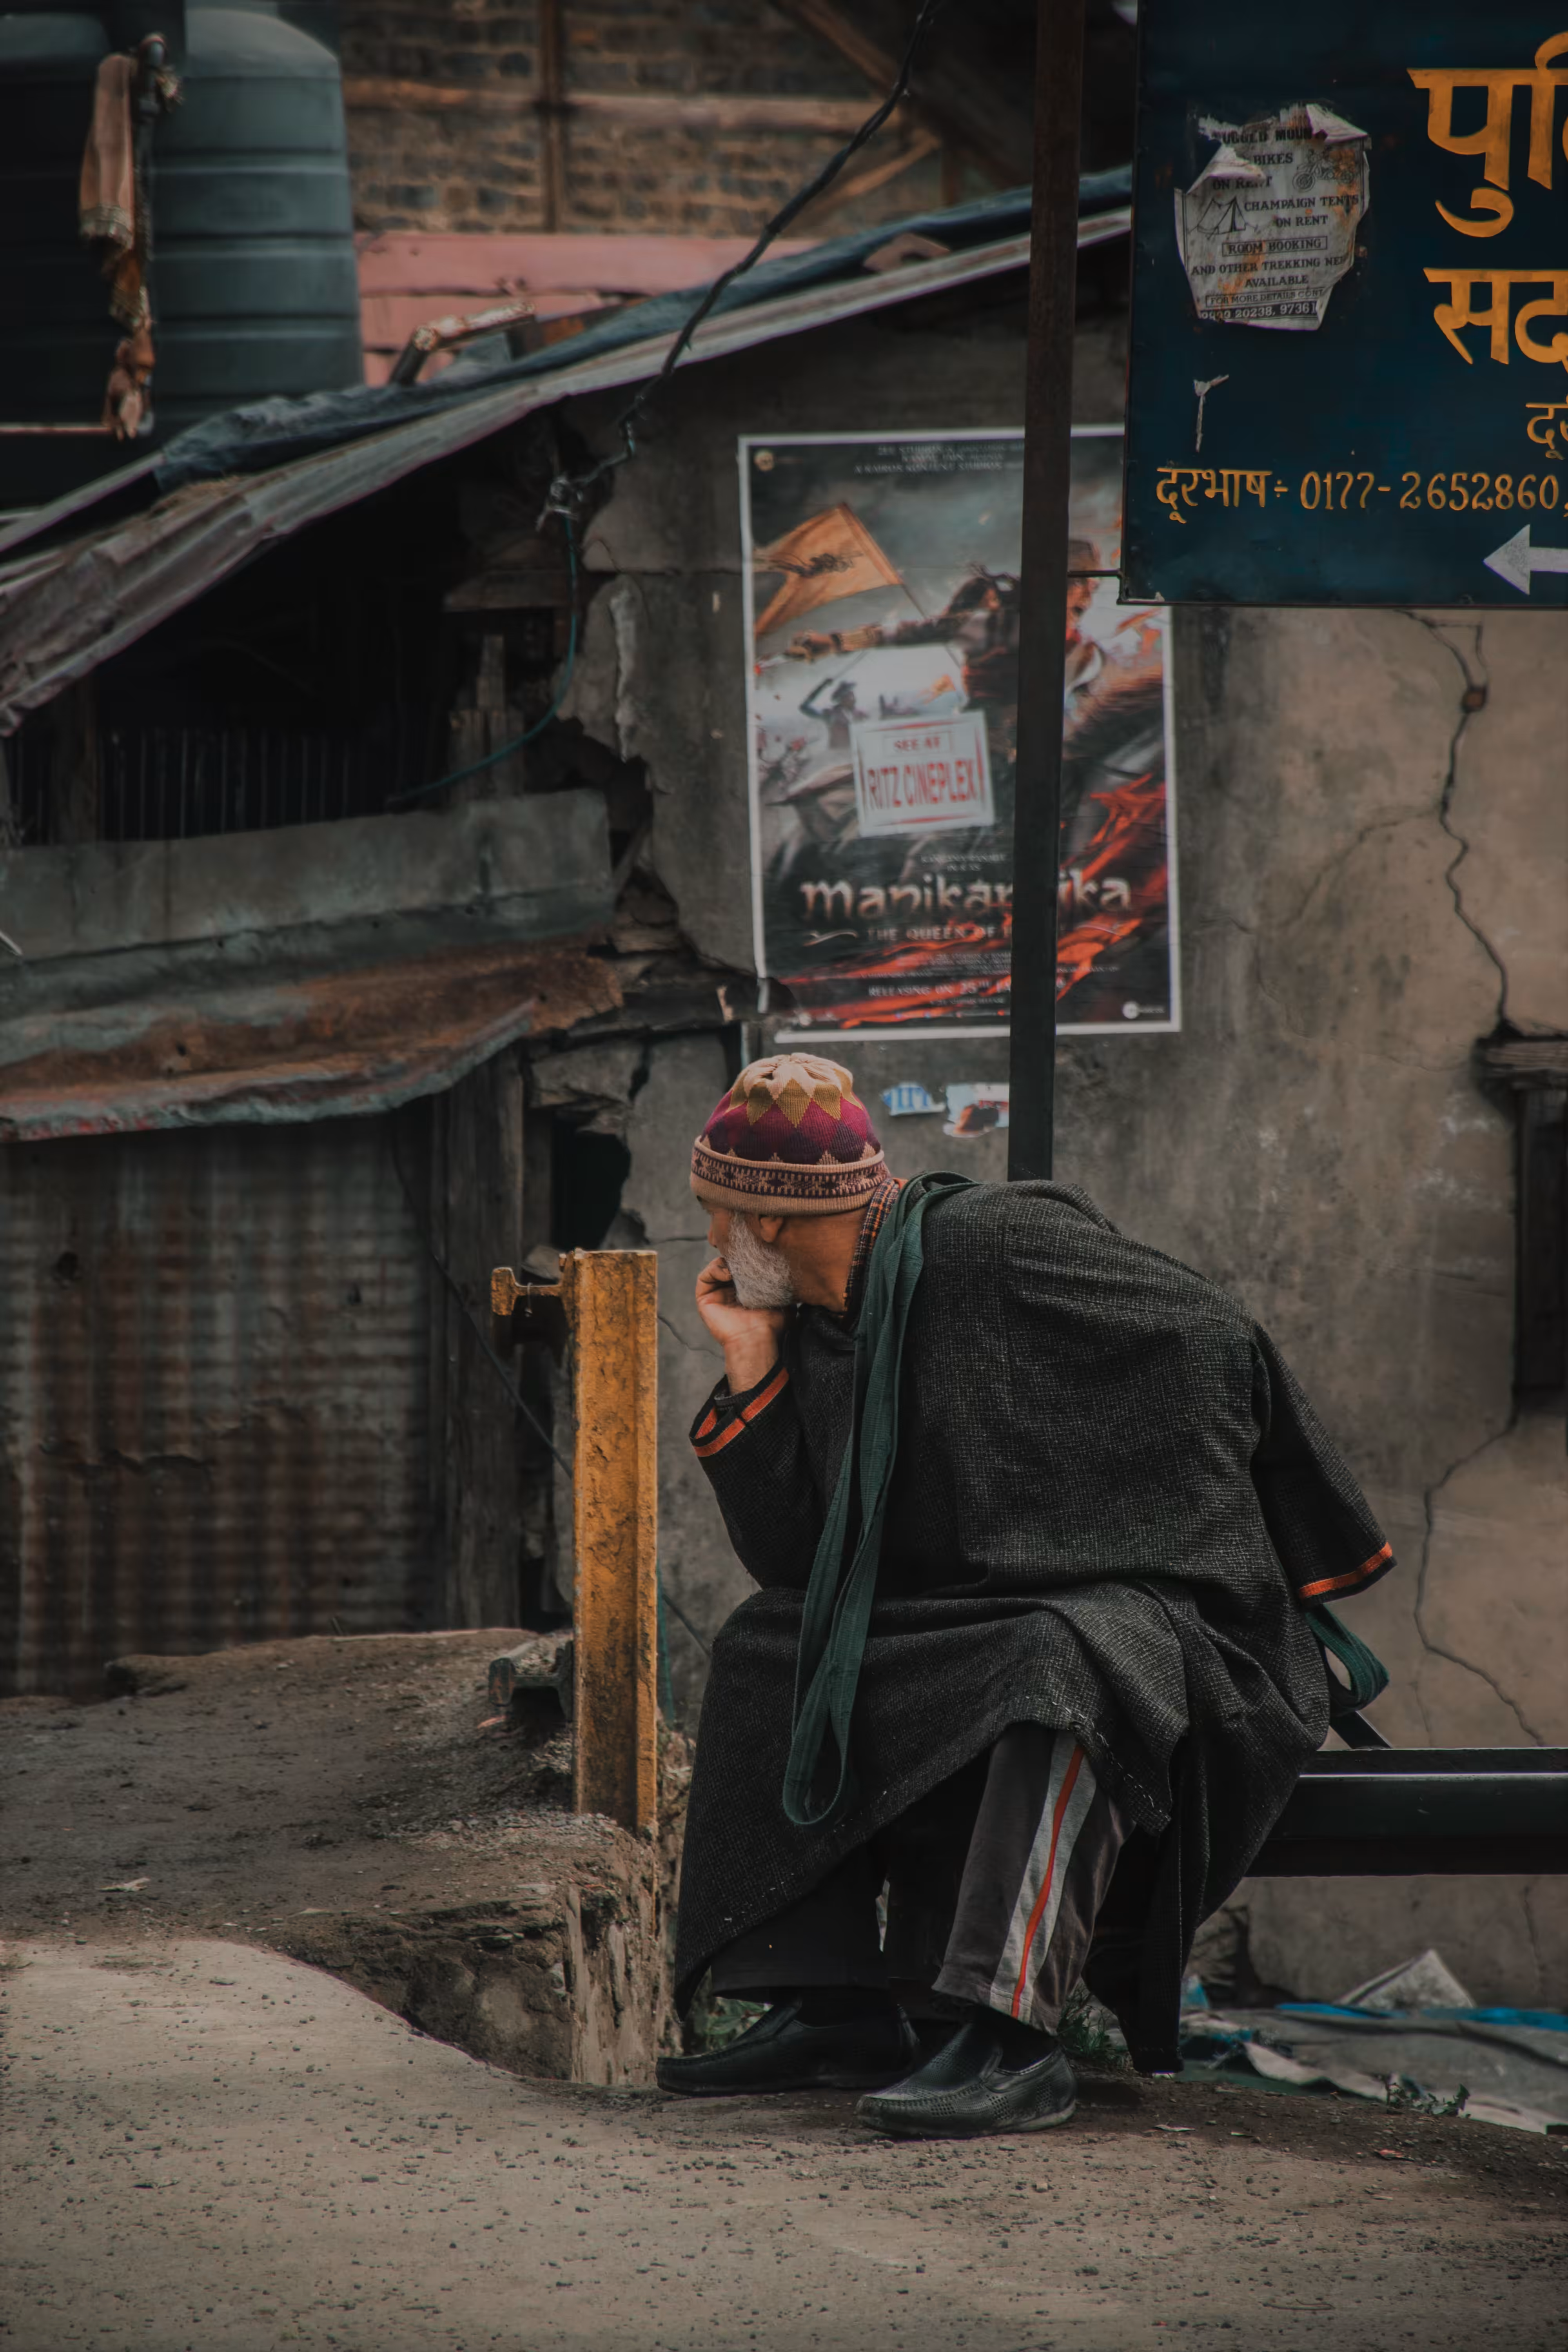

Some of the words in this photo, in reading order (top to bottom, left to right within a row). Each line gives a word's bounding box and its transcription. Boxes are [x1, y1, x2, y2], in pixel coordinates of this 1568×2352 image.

[1254, 152, 1293, 165] BIKES
[1244, 198, 1315, 212] CHAMPAIGN
[1320, 195, 1359, 207] TENTS
[1276, 217, 1291, 228] ON
[1296, 215, 1328, 227] RENT
[1229, 243, 1263, 254] ROOM
[1269, 238, 1321, 251] BOOKING
[1191, 266, 1216, 276] AND
[1220, 263, 1258, 273] OTHER
[1261, 260, 1321, 271] TREKKING
[1245, 275, 1309, 288] AVAILABLE
[1232, 294, 1258, 303] MORE
[1260, 291, 1296, 301] DETAILS
[1235, 306, 1275, 318] 20238,
[894, 739, 918, 752] SEE
[867, 767, 902, 809] RITZ
[904, 758, 978, 807] CINEPLEX
[800, 868, 1133, 920] manikarika
[867, 928, 898, 940] THE
[906, 927, 965, 941] QUEEN
